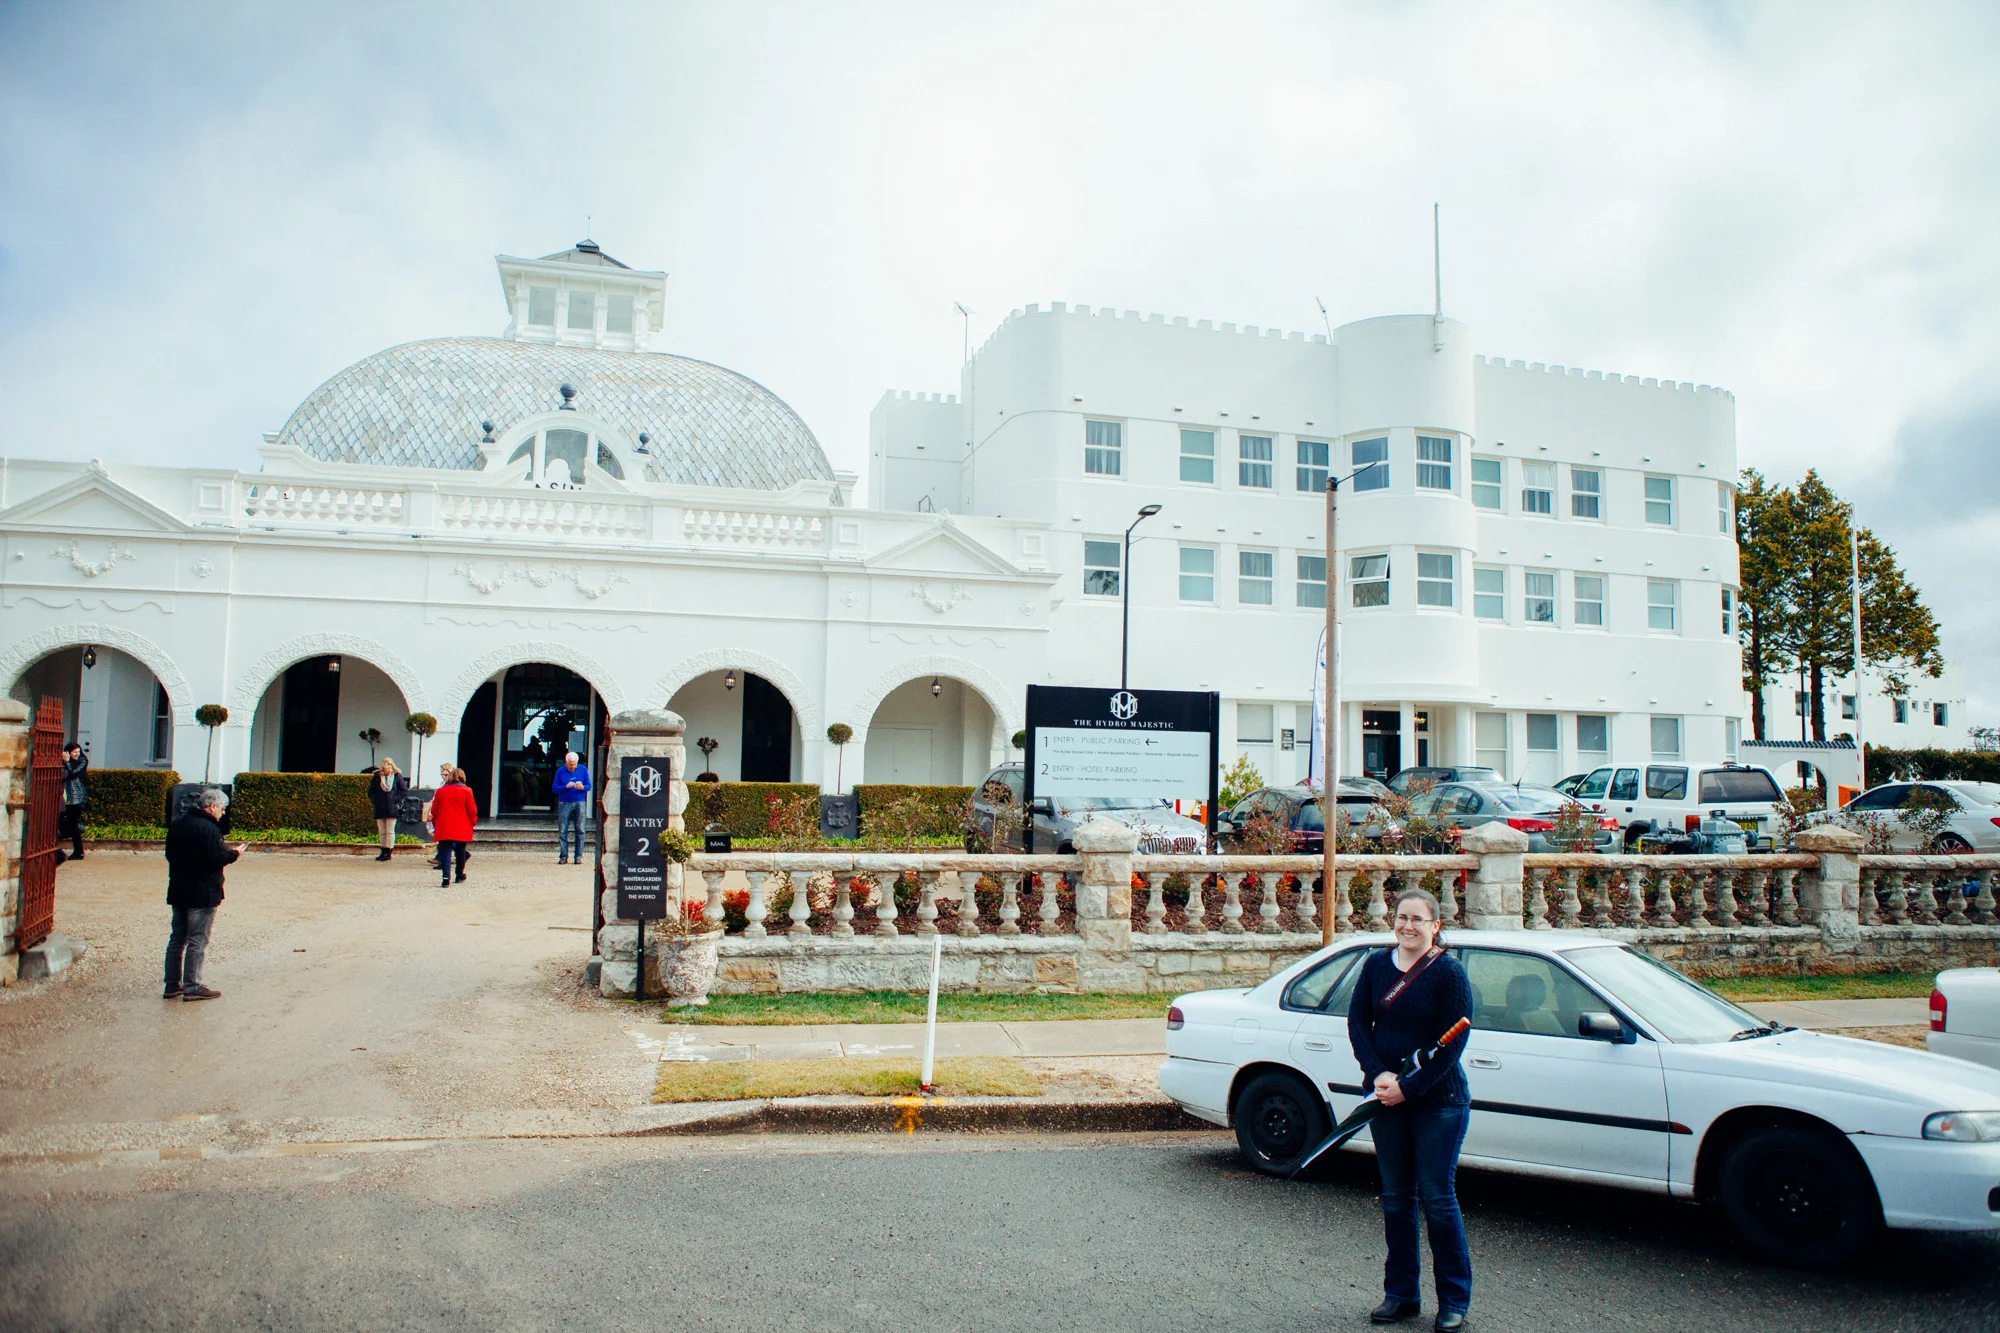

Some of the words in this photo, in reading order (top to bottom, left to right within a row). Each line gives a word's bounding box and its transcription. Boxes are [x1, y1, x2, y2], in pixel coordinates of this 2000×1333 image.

[1044, 736, 1048, 747] 1
[1041, 764, 1048, 775] 2
[624, 818, 664, 828] ENTRY
[637, 837, 650, 856] 2
[1384, 980, 1406, 1001] DIGITAL
